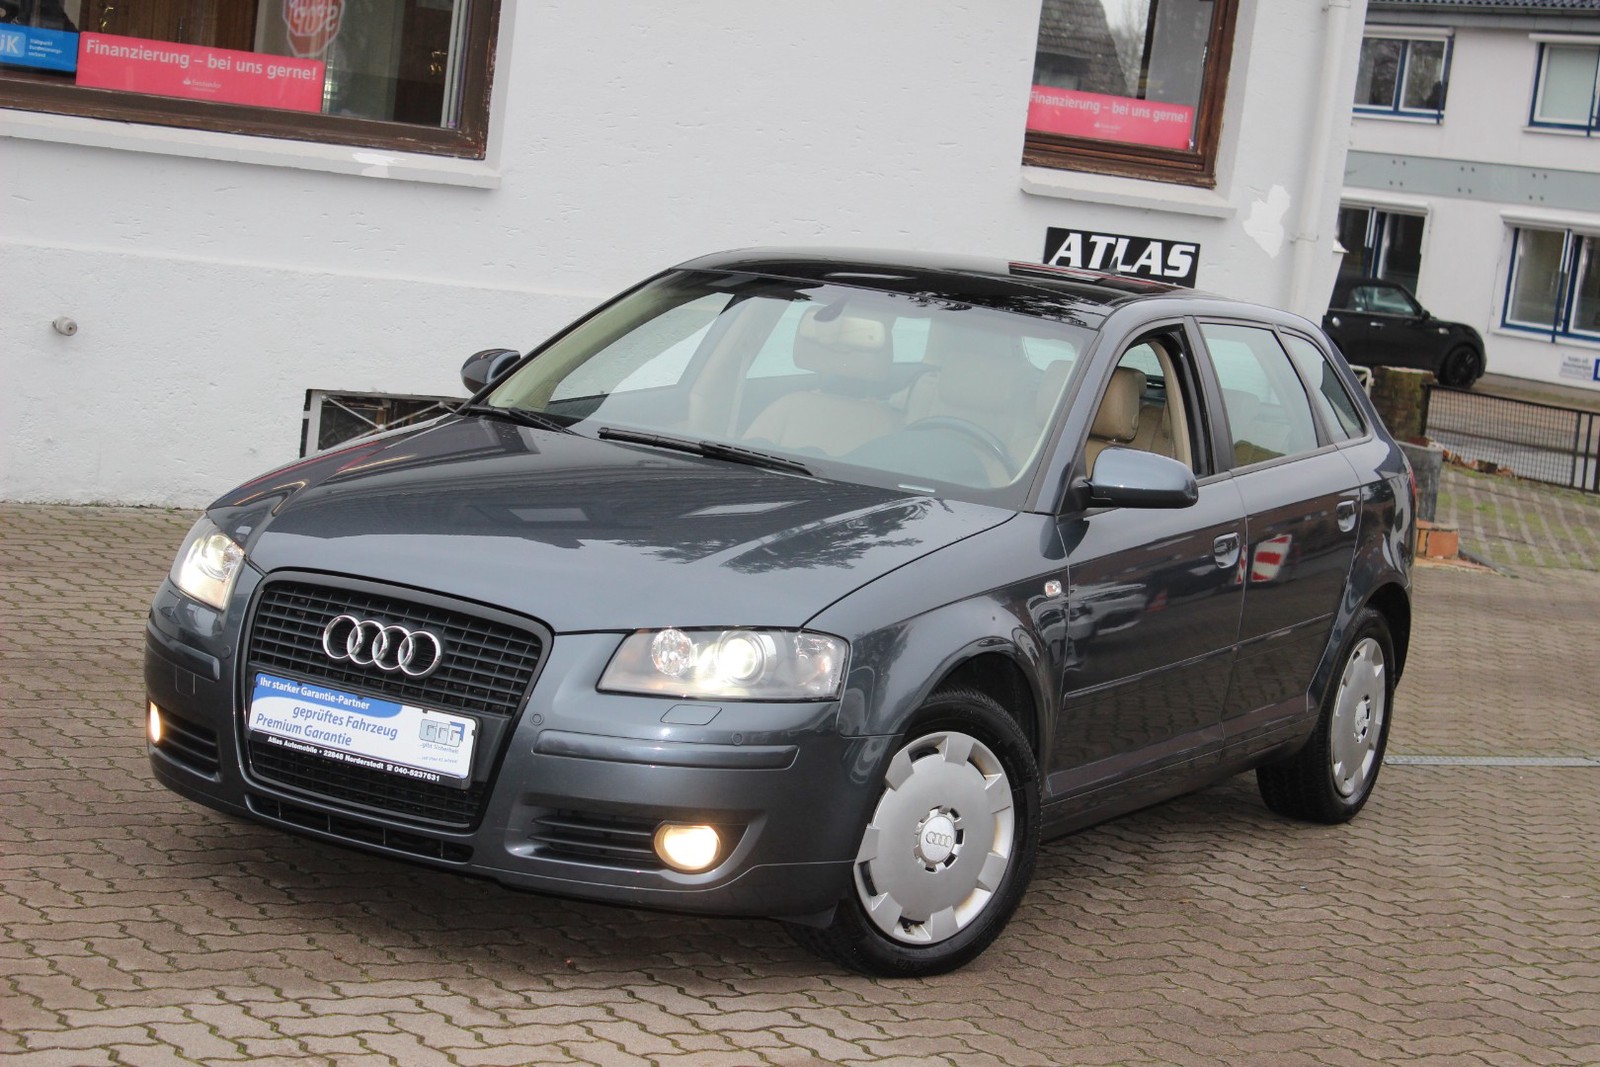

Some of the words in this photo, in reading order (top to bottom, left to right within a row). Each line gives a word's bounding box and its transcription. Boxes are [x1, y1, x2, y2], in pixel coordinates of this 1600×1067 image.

[86, 39, 190, 69] Finanzierung
[207, 55, 232, 72] bei
[236, 61, 263, 75] uns
[267, 63, 317, 82] gerne!
[1030, 91, 1101, 115] Finanzierung
[1112, 101, 1129, 116] bei
[1131, 105, 1151, 117] uns
[1152, 111, 1189, 124] gerne!
[1048, 232, 1197, 279] ATLAS
[260, 676, 271, 688] Ihr
[272, 680, 300, 695] starker
[301, 687, 371, 710] Garantie-Partner
[256, 713, 301, 734] Premium
[304, 725, 352, 747] Garantie
[292, 704, 344, 728] geprüftes
[346, 715, 399, 741] Fahrzeug
[283, 739, 318, 754] Automobile
[345, 754, 384, 770] Norderstedt
